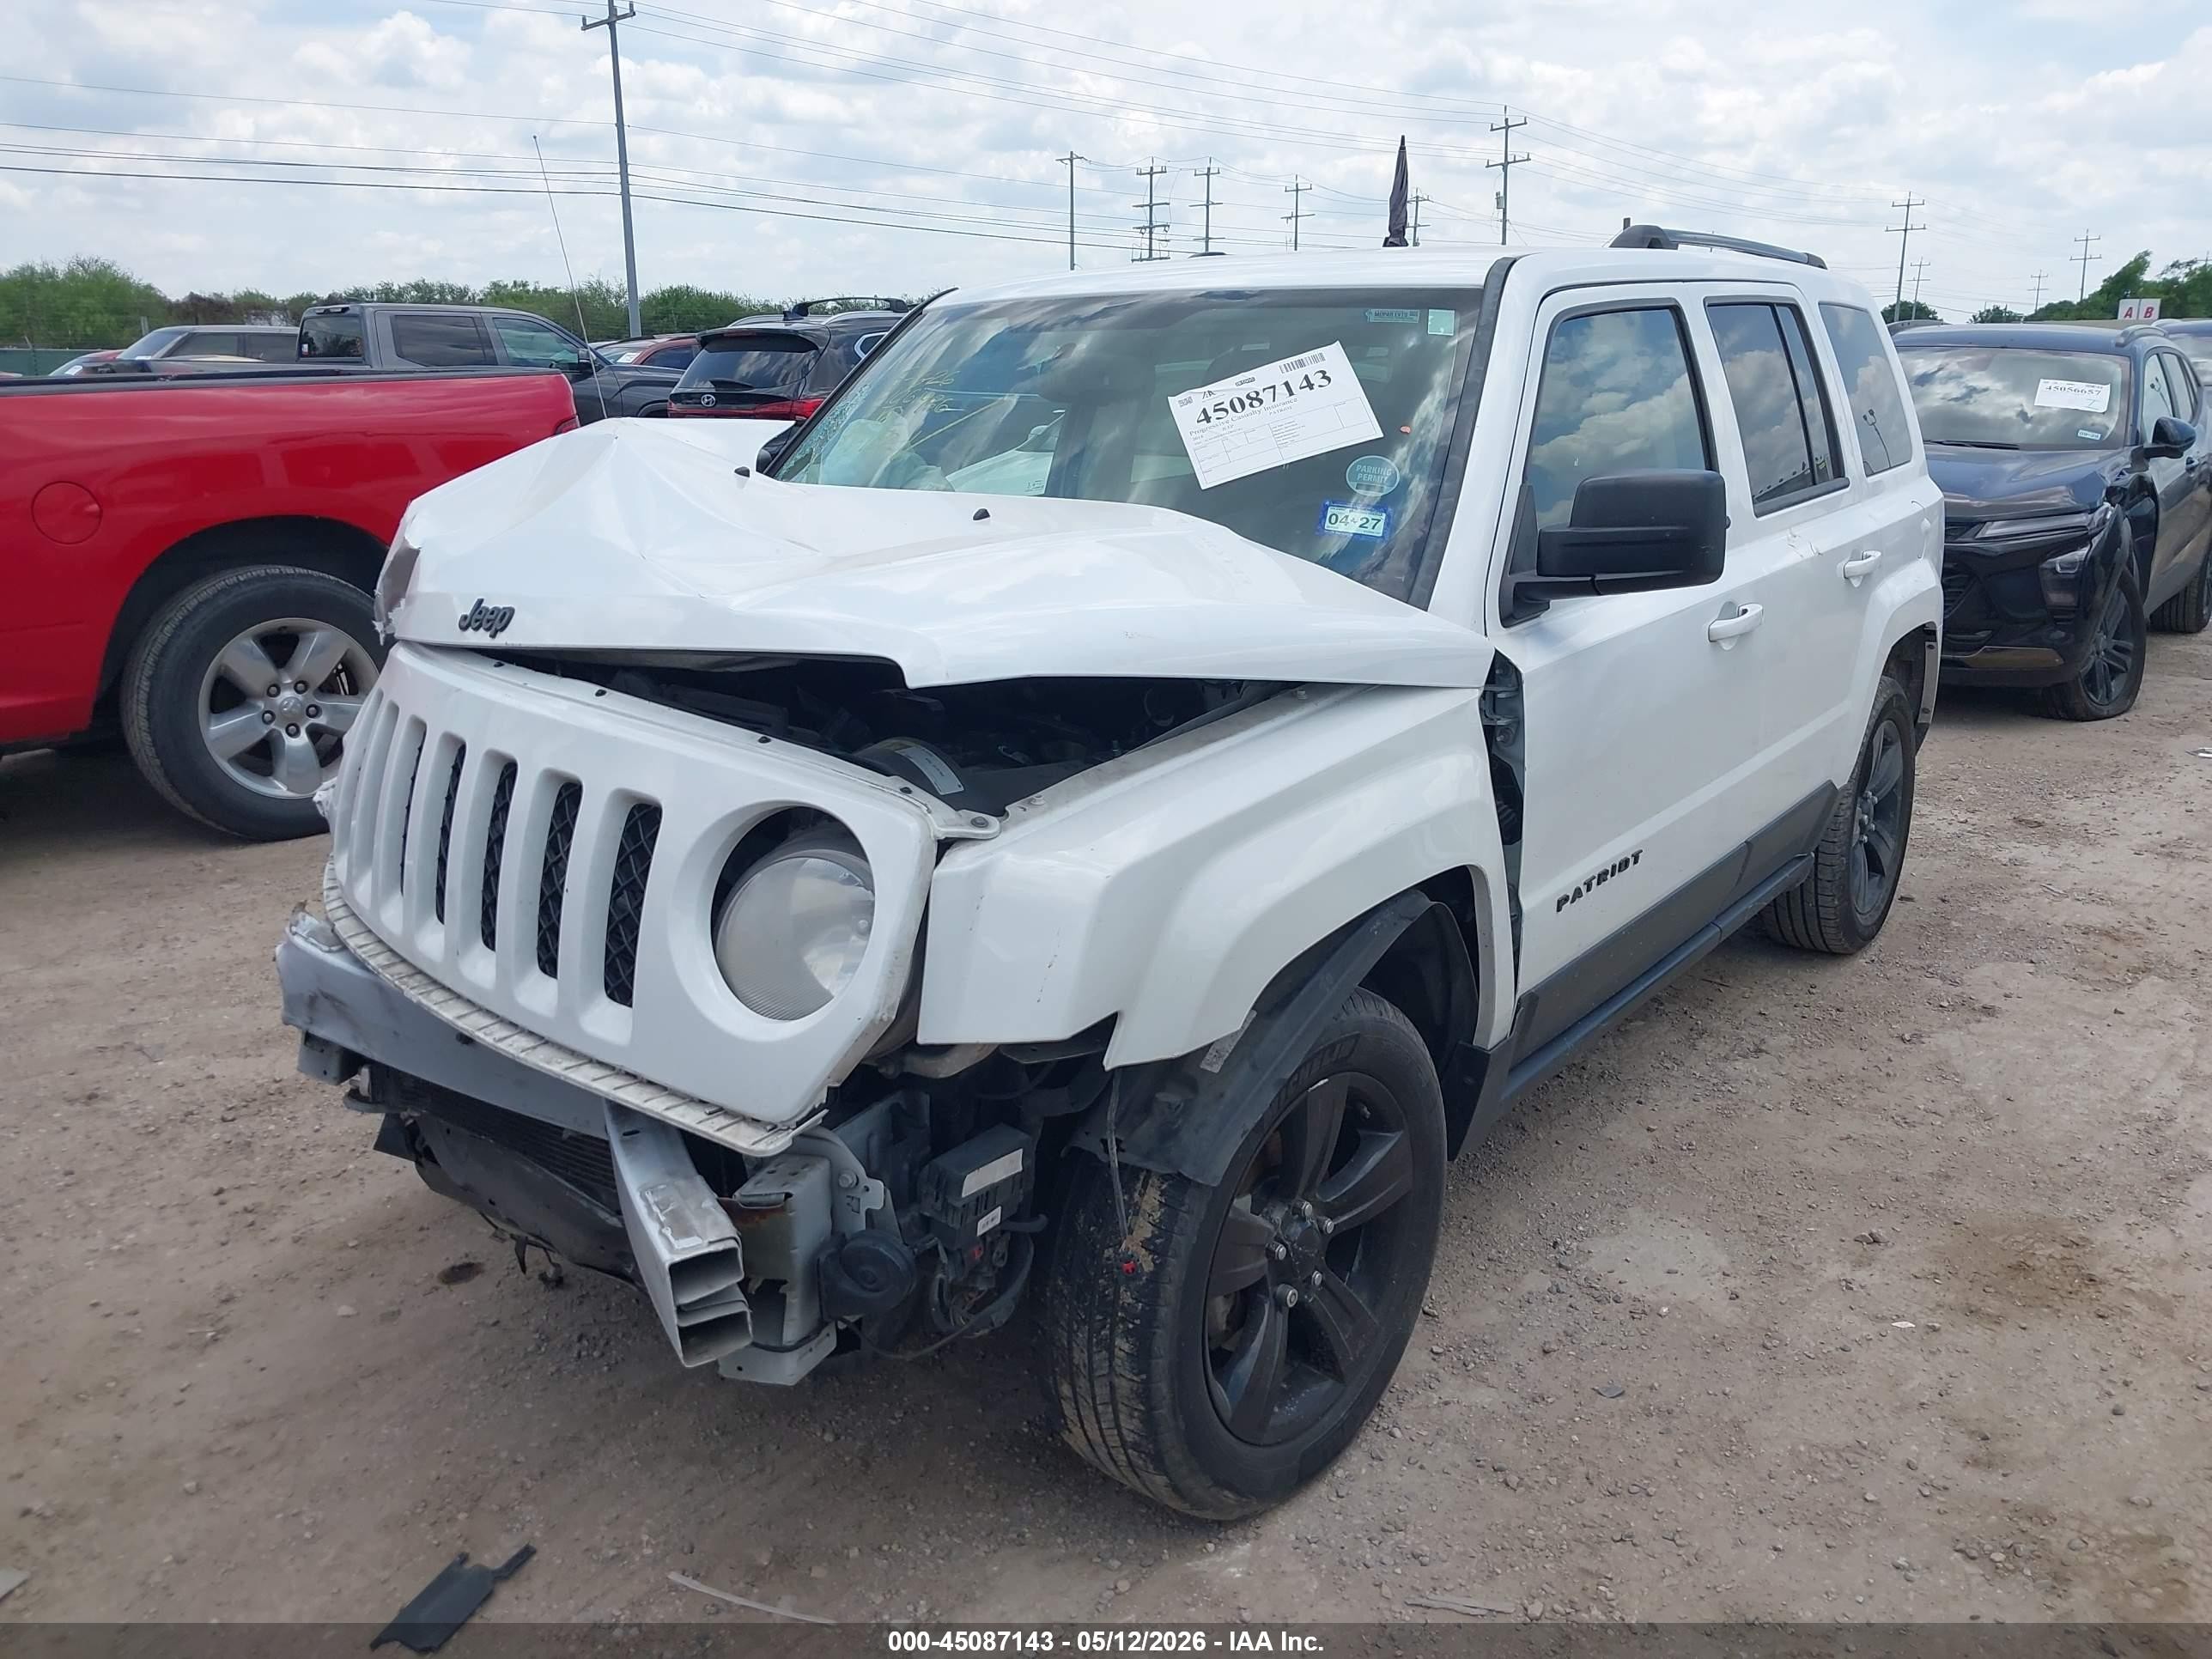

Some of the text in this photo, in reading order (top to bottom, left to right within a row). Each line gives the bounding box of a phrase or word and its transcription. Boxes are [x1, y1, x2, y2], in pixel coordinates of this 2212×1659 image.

[2124, 307, 2133, 319] A
[2143, 306, 2154, 319] B
[1196, 369, 1332, 424] 45087143
[1356, 465, 1392, 476] PARKING
[1357, 472, 1388, 483] PERMIT
[459, 598, 515, 639] Jeep
[1556, 848, 1644, 913] PATRIOT
